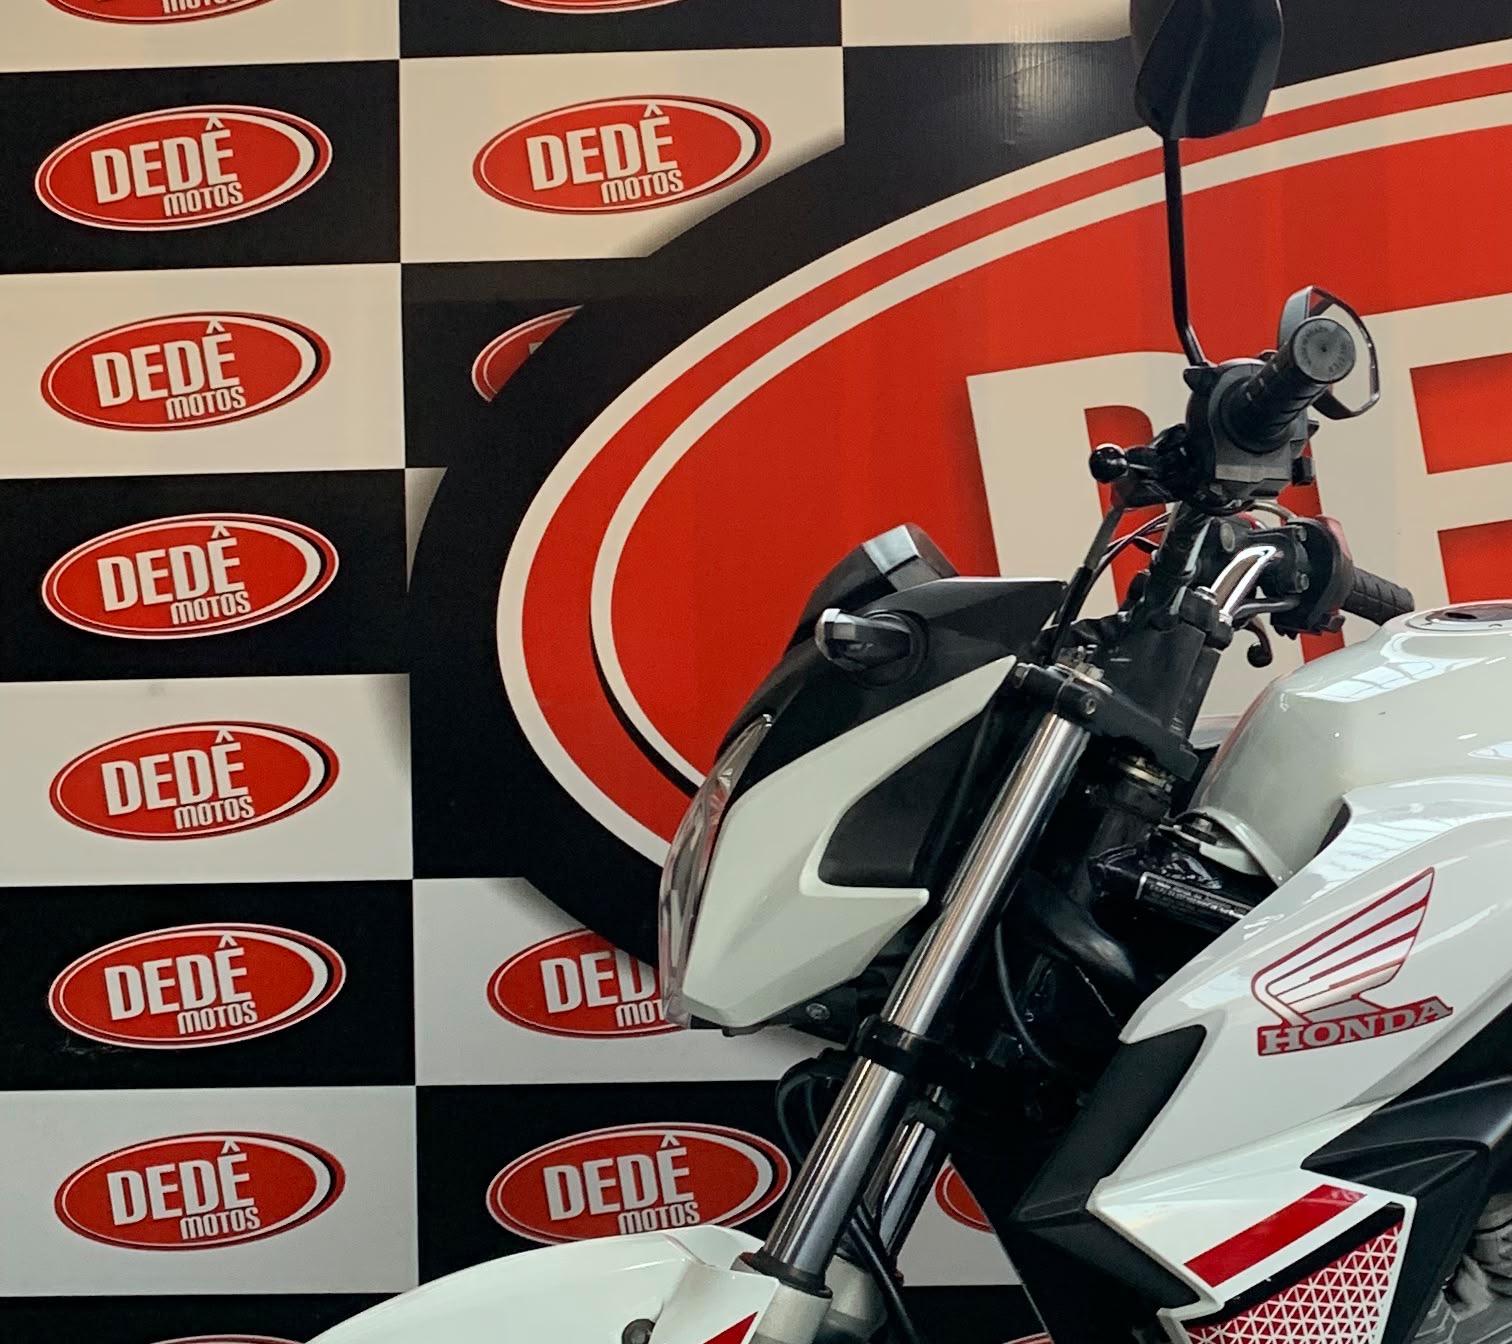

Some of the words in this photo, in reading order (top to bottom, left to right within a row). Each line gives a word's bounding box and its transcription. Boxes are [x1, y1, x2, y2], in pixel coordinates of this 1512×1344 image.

[91, 115, 238, 204] DEDÊ
[526, 102, 678, 191] DEDÊ
[163, 181, 244, 217] MOTOS
[601, 169, 684, 204] MOTOS
[92, 319, 240, 407] DEDÊ
[165, 385, 246, 421] MOTOS
[97, 523, 245, 612] DEDÊ
[170, 590, 251, 625] MOTOS
[101, 728, 249, 816] DEDÊ
[174, 795, 255, 830] MOTOS
[104, 933, 252, 1021] DEDÊ
[540, 950, 656, 1013] DED
[177, 1000, 258, 1035] MOTOS
[1260, 998, 1448, 1055] HONDA
[107, 1139, 255, 1226] DEDÊ
[543, 1133, 695, 1220] DEDÊ
[179, 1206, 261, 1240] MOTOS
[617, 1199, 700, 1233] MOTOS
